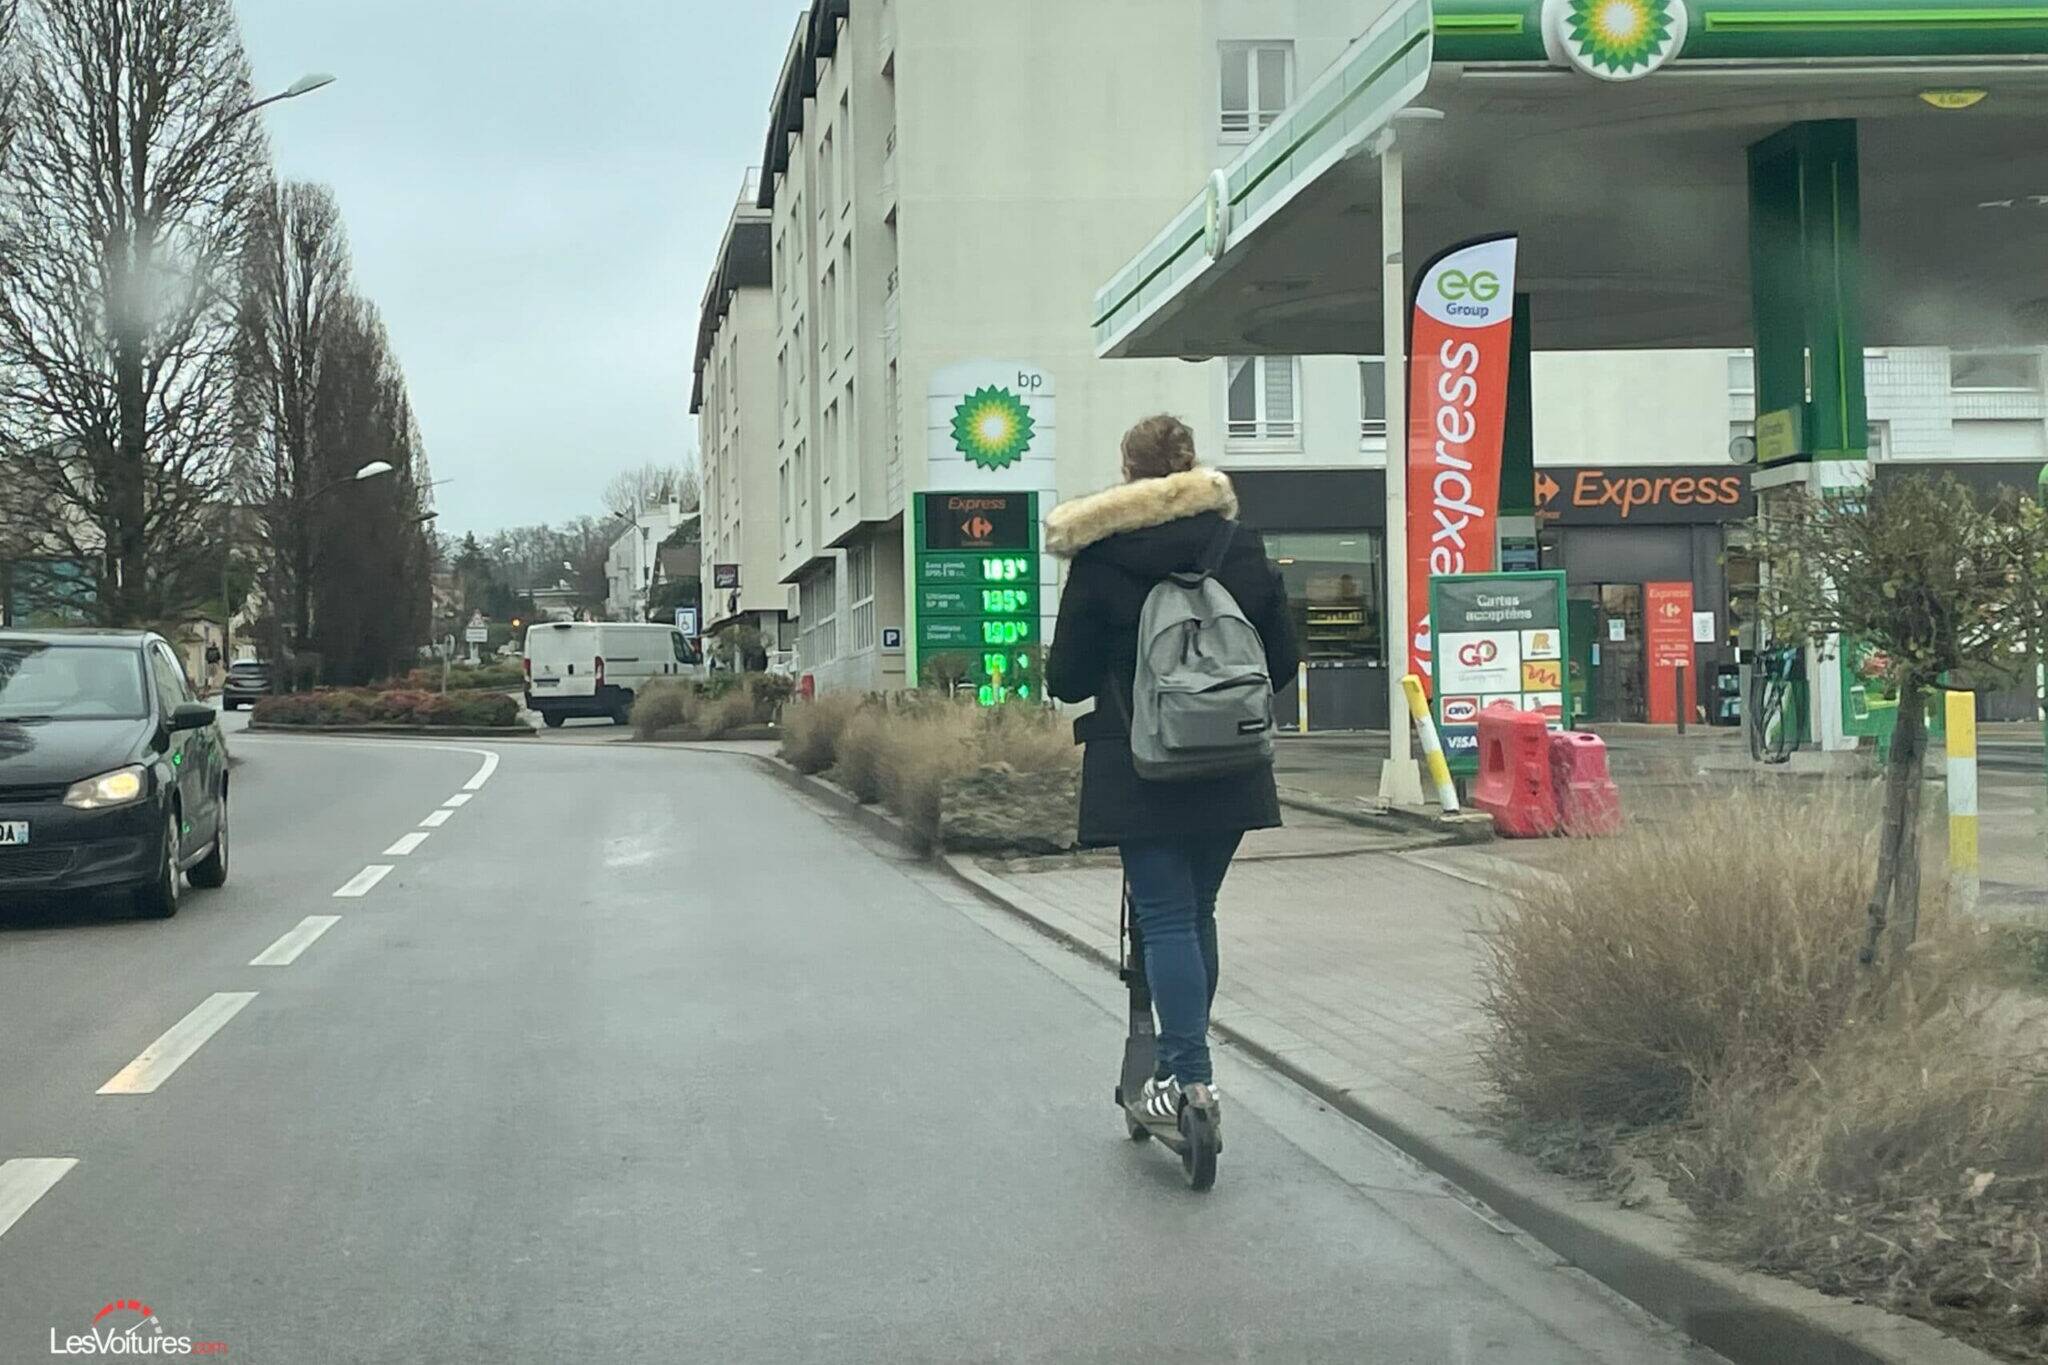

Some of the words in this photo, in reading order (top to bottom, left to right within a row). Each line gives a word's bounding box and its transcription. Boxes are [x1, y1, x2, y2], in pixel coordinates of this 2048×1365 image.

[1446, 302, 1489, 319] Group
[1017, 371, 1042, 391] bp
[1428, 339, 1485, 575] express
[1572, 470, 1741, 518] Express
[948, 497, 1006, 511] Express
[1477, 594, 1520, 607] Cartes
[886, 631, 898, 645] P
[1447, 736, 1479, 749] VISA
